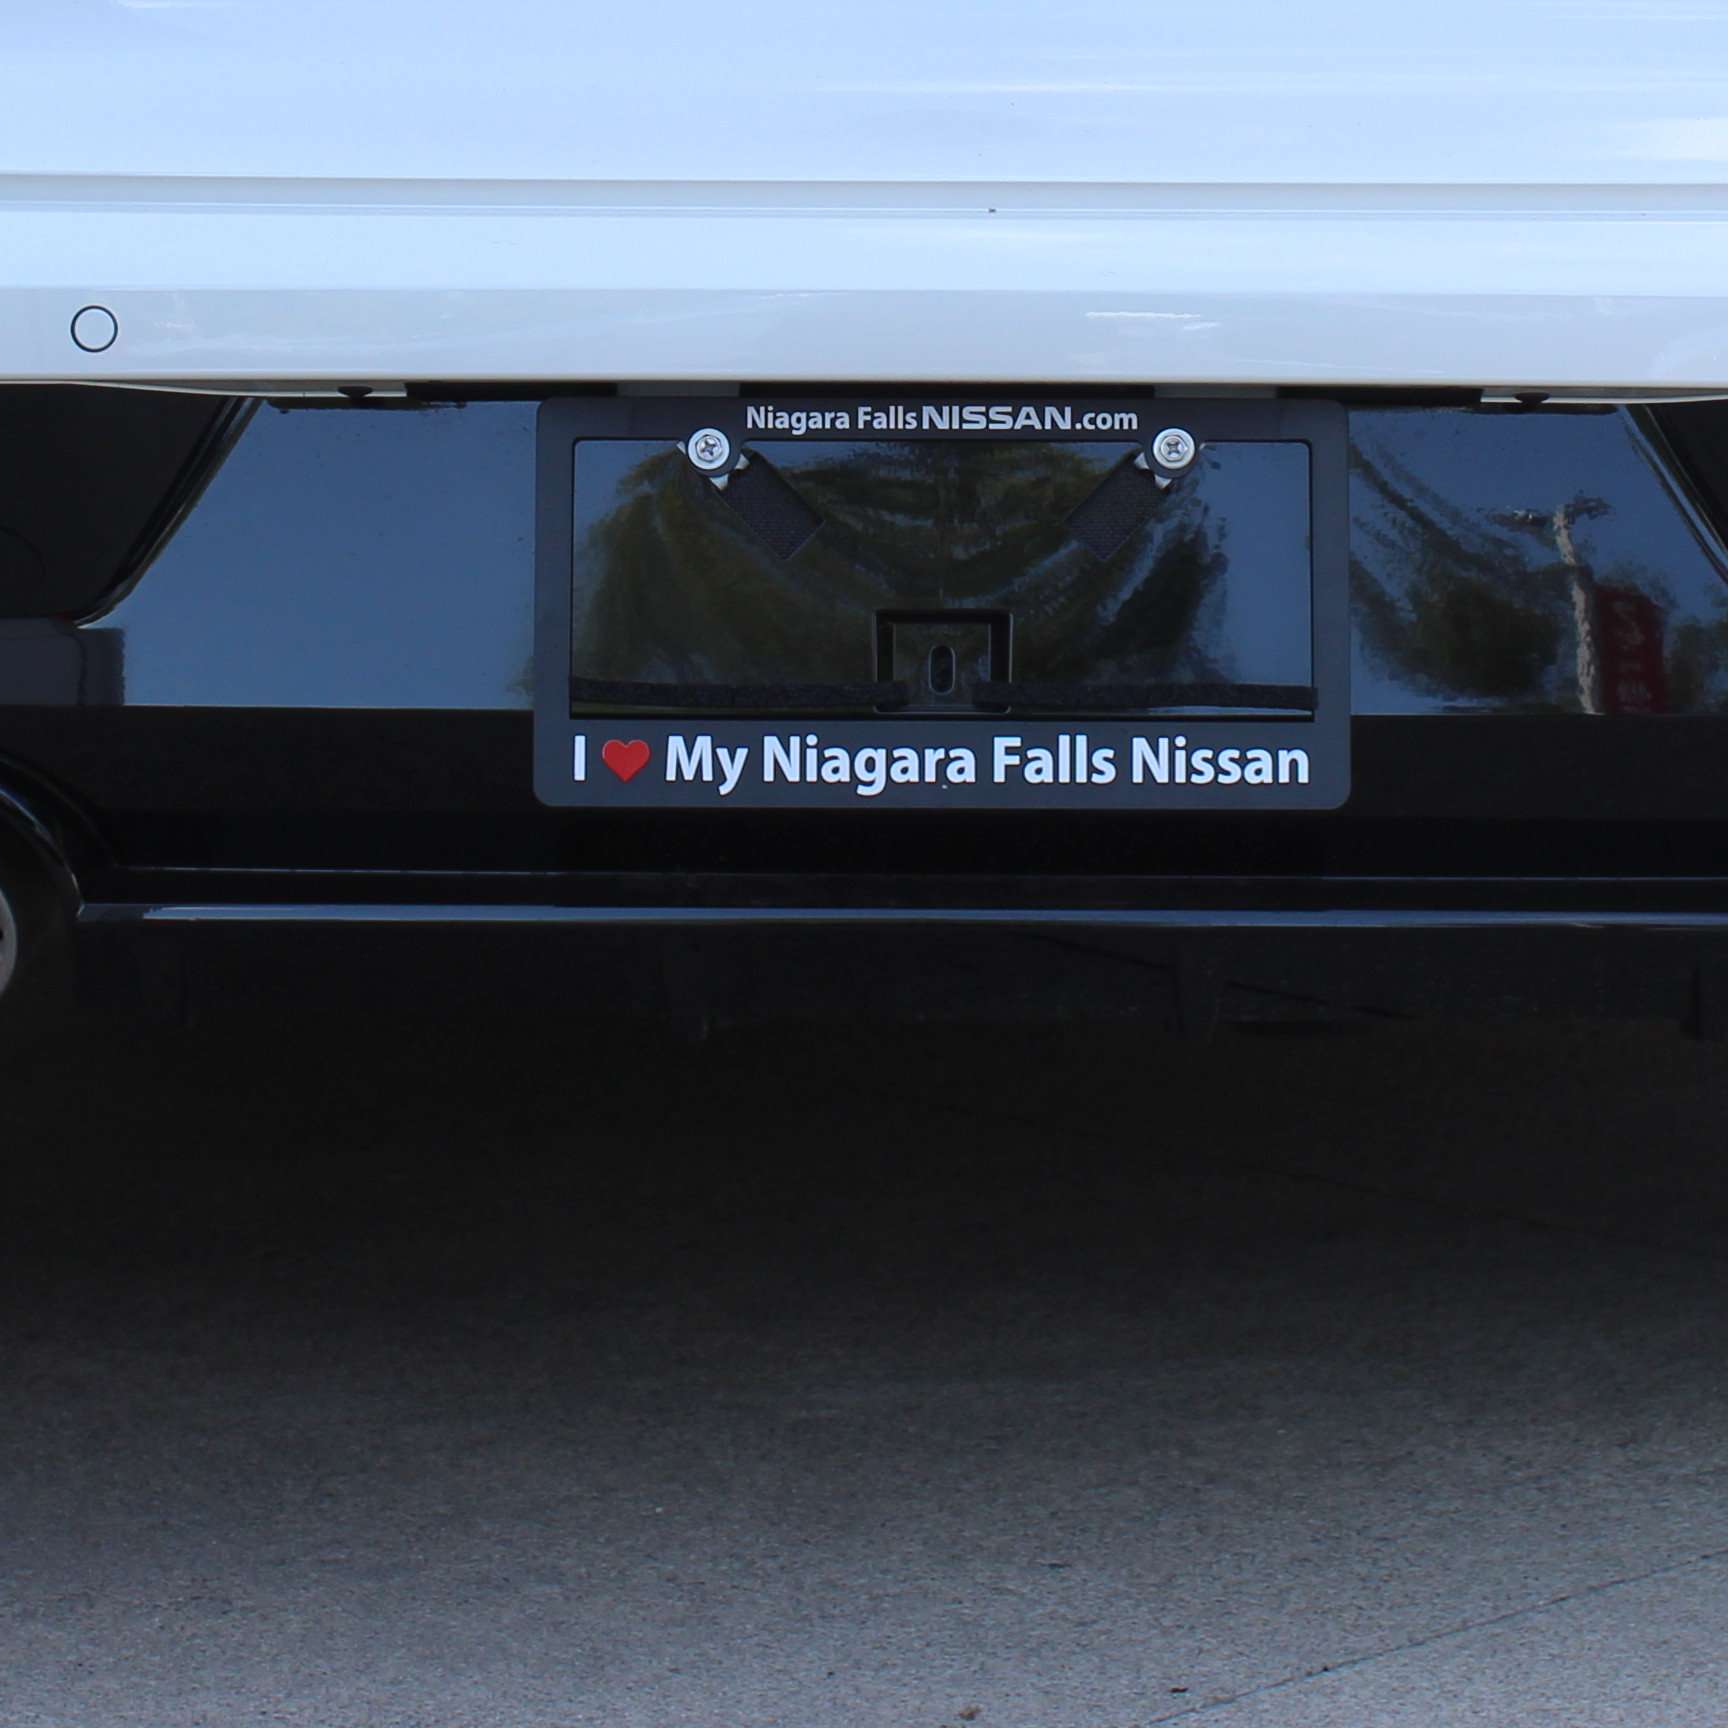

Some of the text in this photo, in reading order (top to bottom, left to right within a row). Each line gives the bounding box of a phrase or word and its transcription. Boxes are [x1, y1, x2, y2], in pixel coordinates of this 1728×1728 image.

[745, 405, 1139, 436] Niagara Falls NISSAN.com
[573, 734, 1310, 797] I My Niagara Falls Nissan
